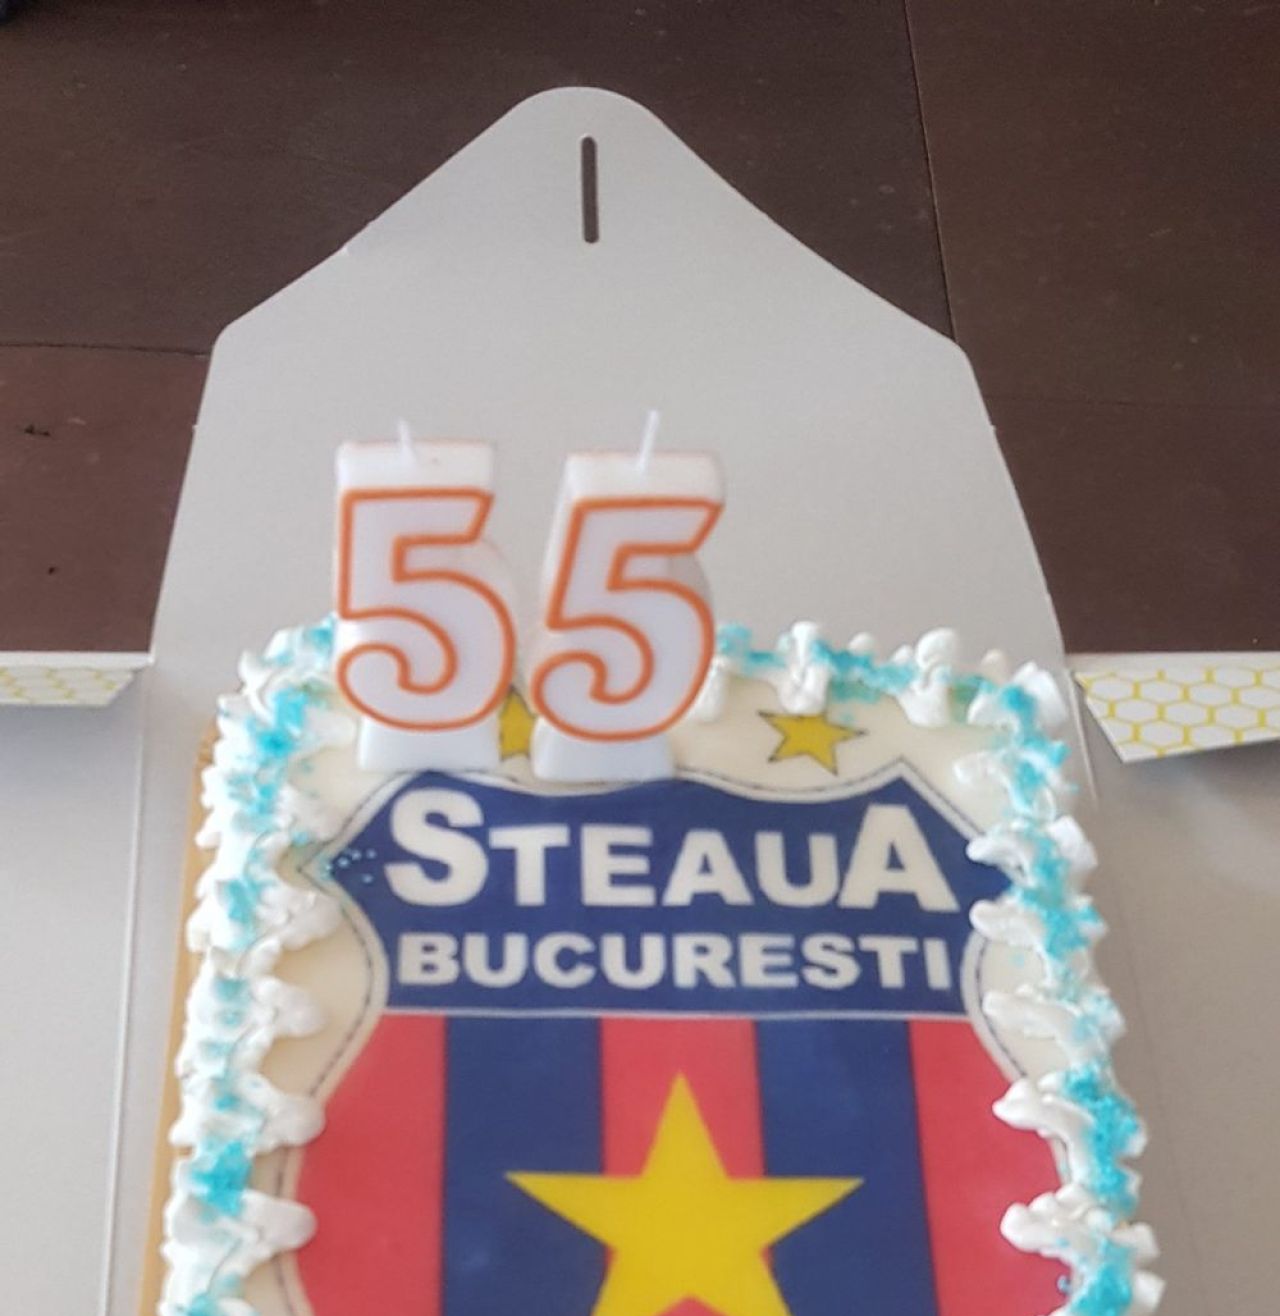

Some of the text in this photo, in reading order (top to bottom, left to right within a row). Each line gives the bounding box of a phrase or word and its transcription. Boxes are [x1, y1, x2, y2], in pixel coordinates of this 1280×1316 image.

[336, 487, 725, 742] 55
[384, 787, 960, 912] STEAUA
[398, 932, 952, 990] BUCURESTI
